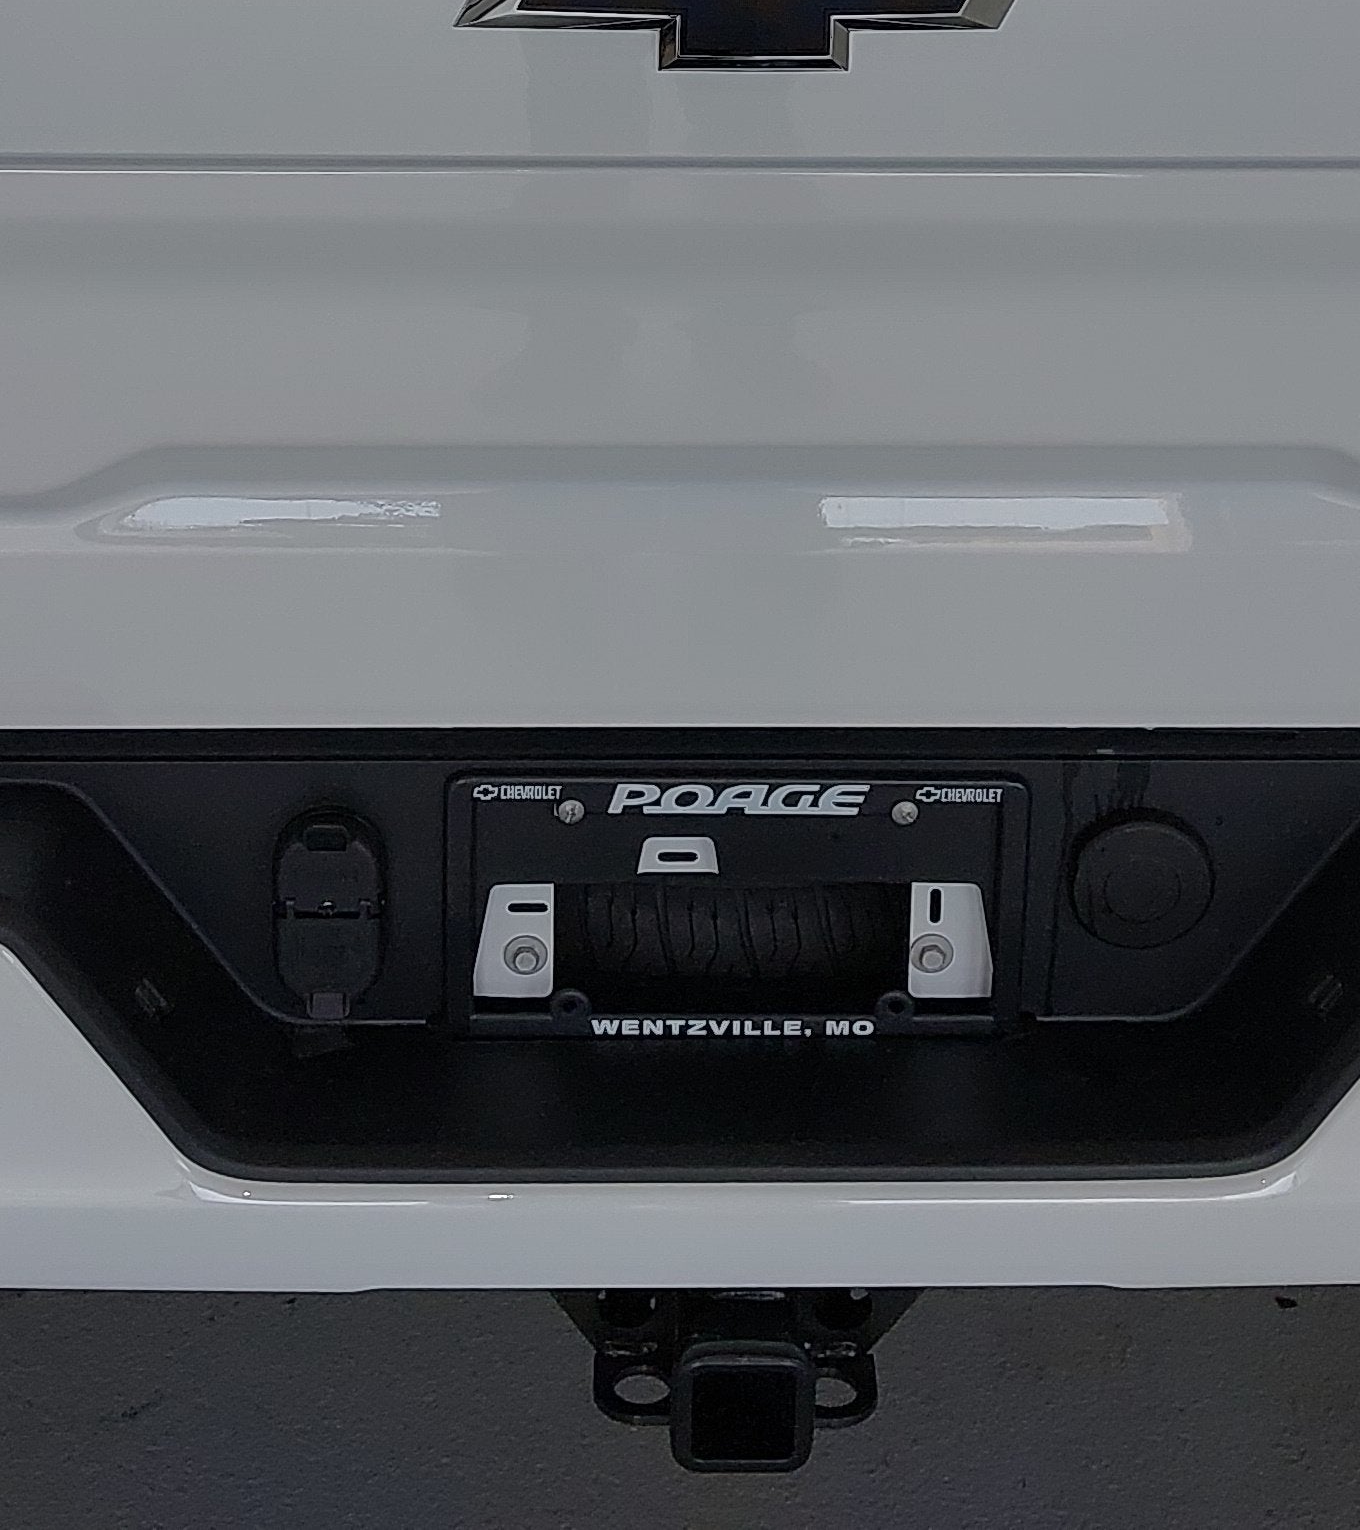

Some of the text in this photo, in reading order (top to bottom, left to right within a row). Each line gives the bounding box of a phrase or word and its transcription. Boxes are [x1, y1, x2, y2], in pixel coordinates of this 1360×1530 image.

[500, 785, 563, 800] CHEVROLET
[607, 783, 871, 816] POAGE
[941, 787, 1003, 803] CHEVROLET
[591, 1019, 875, 1038] WENTZVILLE, MO
